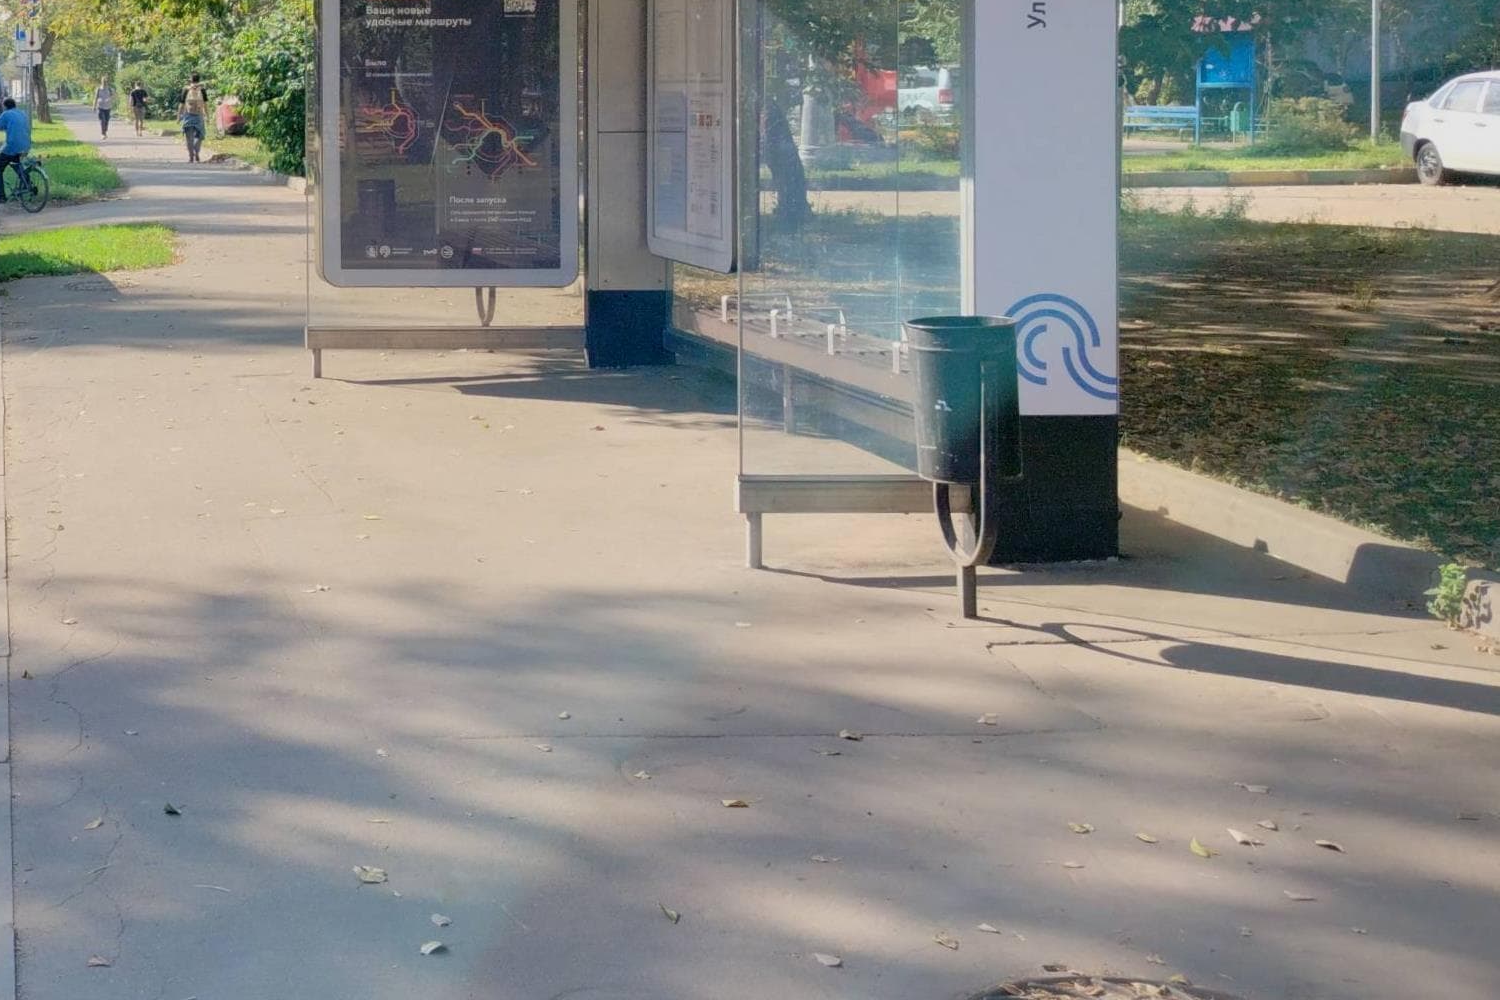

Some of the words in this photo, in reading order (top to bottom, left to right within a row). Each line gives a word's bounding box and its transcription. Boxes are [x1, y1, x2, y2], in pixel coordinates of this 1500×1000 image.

[366, 6, 395, 15] Ваши
[397, 7, 432, 15] новые
[365, 17, 412, 28] удобные
[416, 18, 472, 27] маршруты
[449, 196, 475, 204] После
[476, 197, 507, 206] запуска
